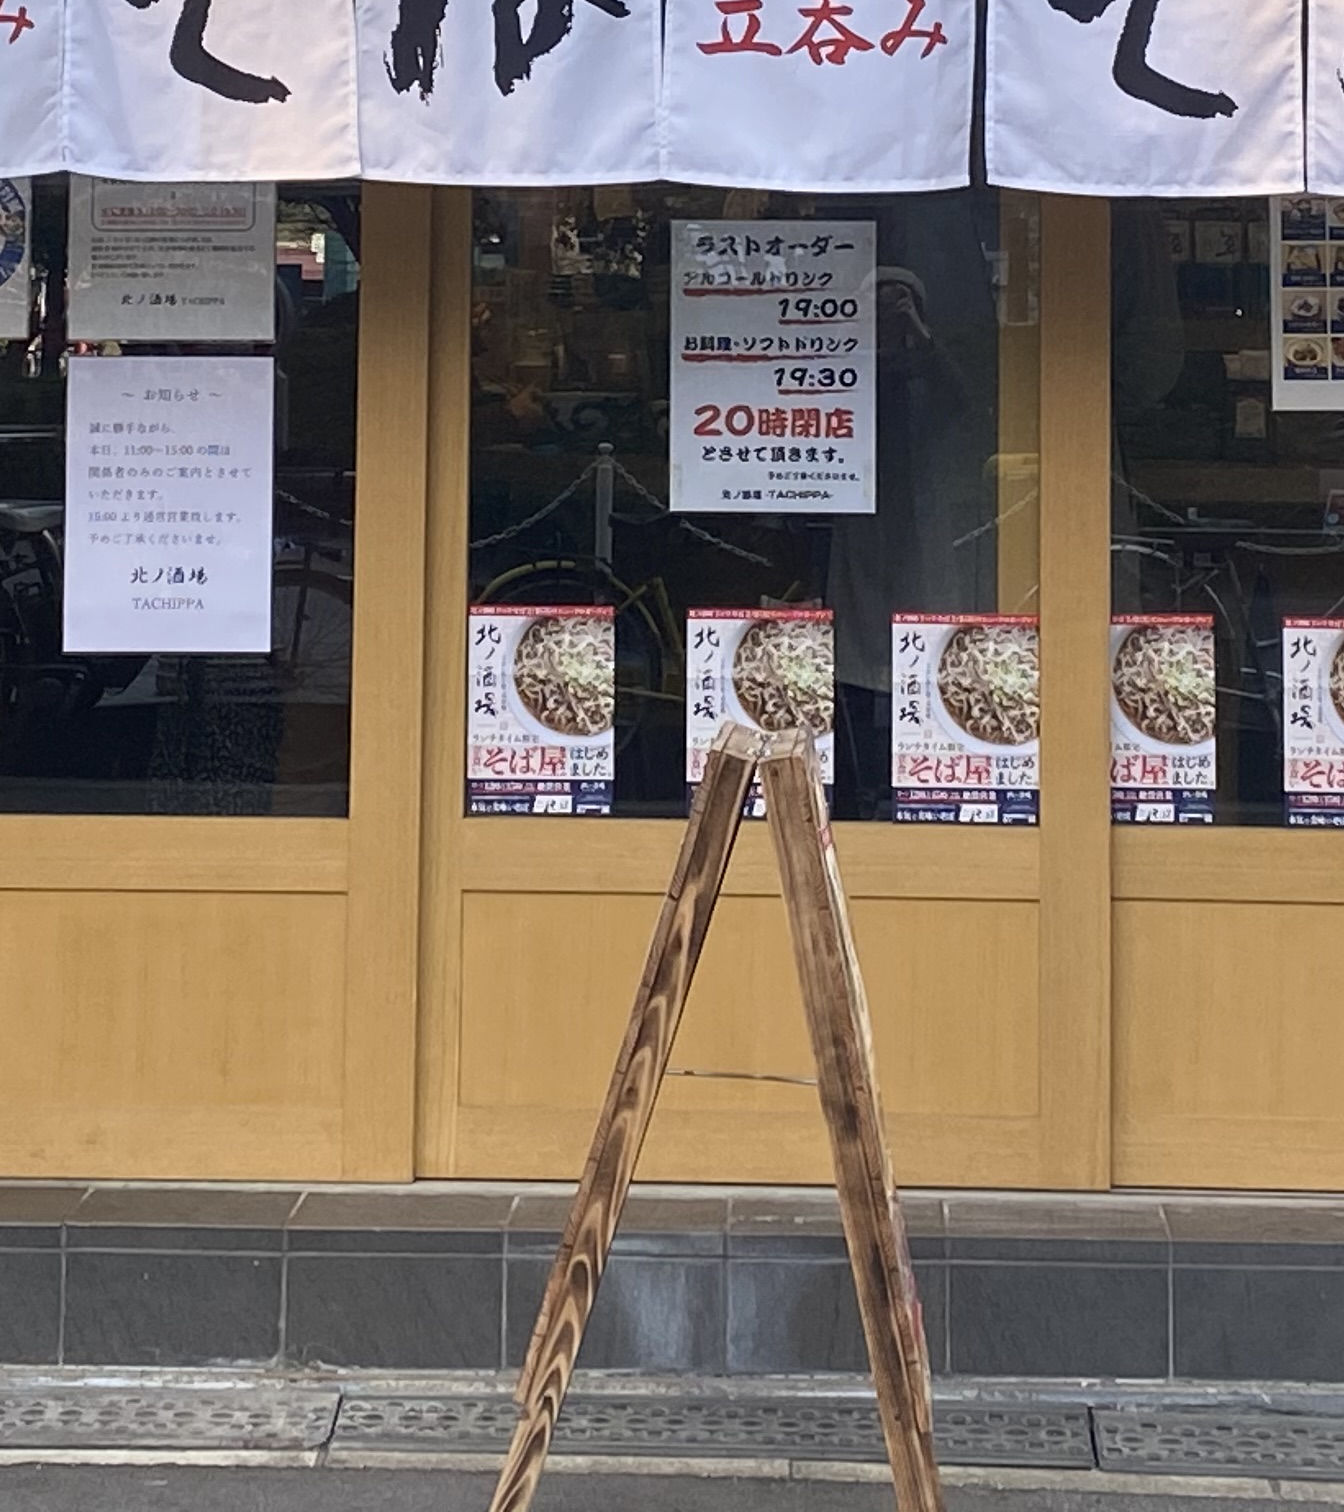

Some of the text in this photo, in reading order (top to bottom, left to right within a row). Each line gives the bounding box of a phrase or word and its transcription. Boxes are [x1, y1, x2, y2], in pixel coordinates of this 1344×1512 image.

[695, 235, 855, 257] ラストオーダー
[777, 298, 857, 318] 19:00
[774, 367, 857, 388] 19:30
[143, 388, 200, 403] お知らせ
[693, 404, 855, 439] 20時閉店
[483, 746, 567, 777] そば屋
[570, 747, 609, 761] はじめ
[996, 755, 1035, 769] はじめ
[1172, 755, 1211, 769] はじめ
[909, 754, 992, 785] そば屋
